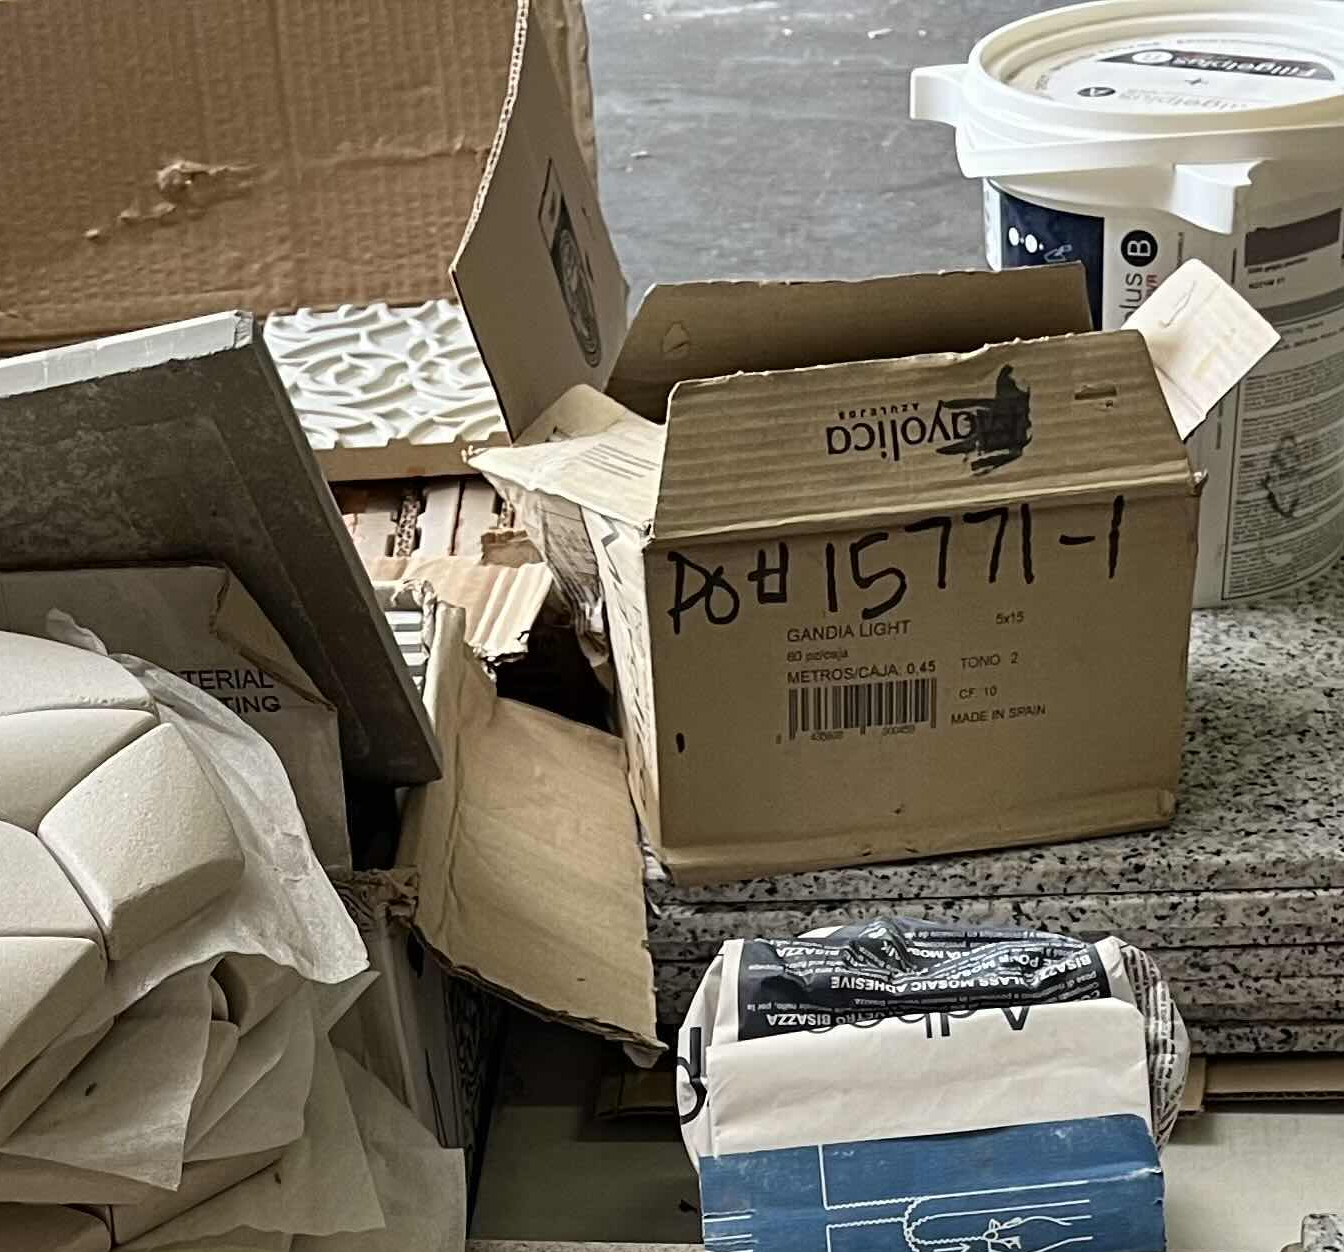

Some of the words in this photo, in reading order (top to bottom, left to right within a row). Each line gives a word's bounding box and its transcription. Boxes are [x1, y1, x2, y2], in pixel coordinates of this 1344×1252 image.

[1127, 240, 1152, 257] B
[837, 401, 919, 420] AZULEJOS
[824, 401, 1025, 463] ayolica
[824, 495, 1126, 620] 15771-1
[995, 611, 1025, 625] 5x15
[786, 625, 855, 642] GANDIA
[859, 620, 911, 638] LIGHT
[960, 653, 1001, 670] TONO
[1010, 651, 1020, 665] 2
[179, 669, 274, 689] TERIAL
[221, 695, 282, 714] TING
[950, 709, 988, 725] MADE
[992, 707, 1006, 720] IN
[1008, 704, 1047, 719] SPAIN
[830, 976, 908, 994] ADHESIVE
[909, 978, 975, 994] MOSAIC
[766, 1013, 831, 1026] BISAZZA
